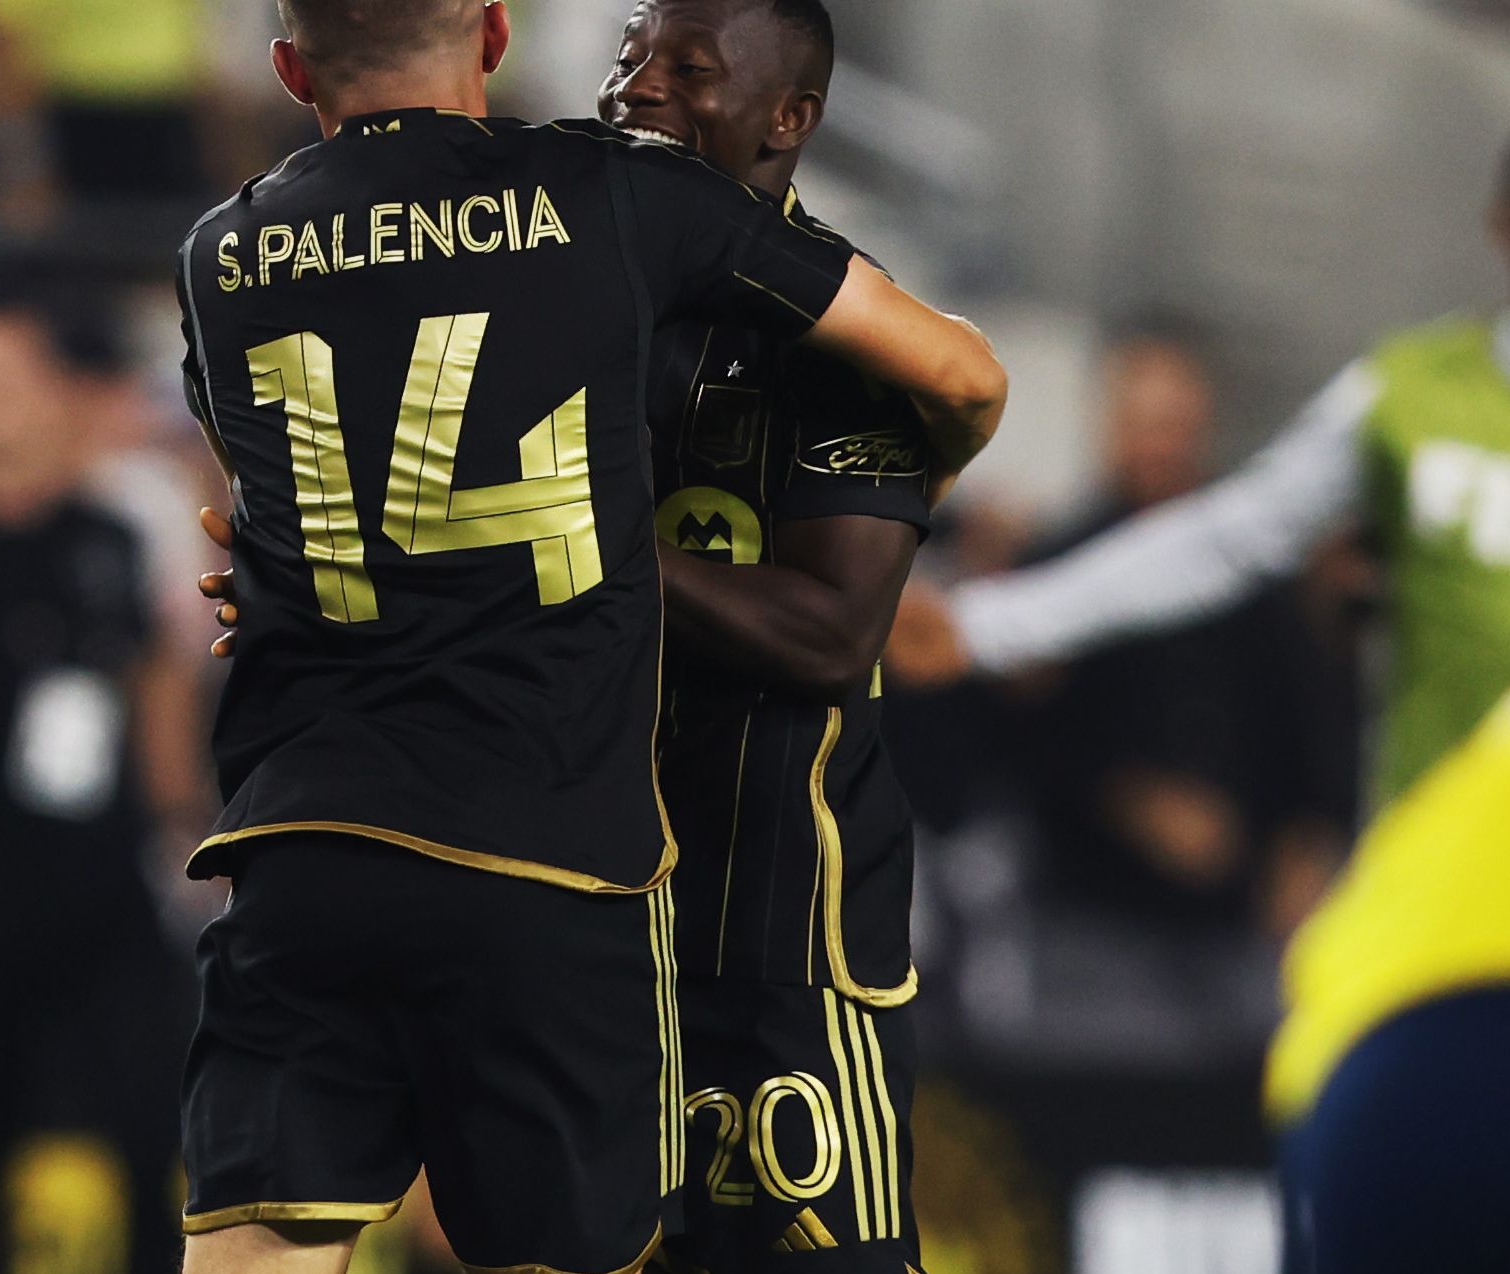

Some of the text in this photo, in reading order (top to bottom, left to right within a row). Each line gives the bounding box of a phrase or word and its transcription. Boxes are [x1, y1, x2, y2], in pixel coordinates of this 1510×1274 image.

[217, 185, 571, 292] S.PALENCIA
[245, 312, 603, 624] 14
[684, 1071, 842, 1206] 20
